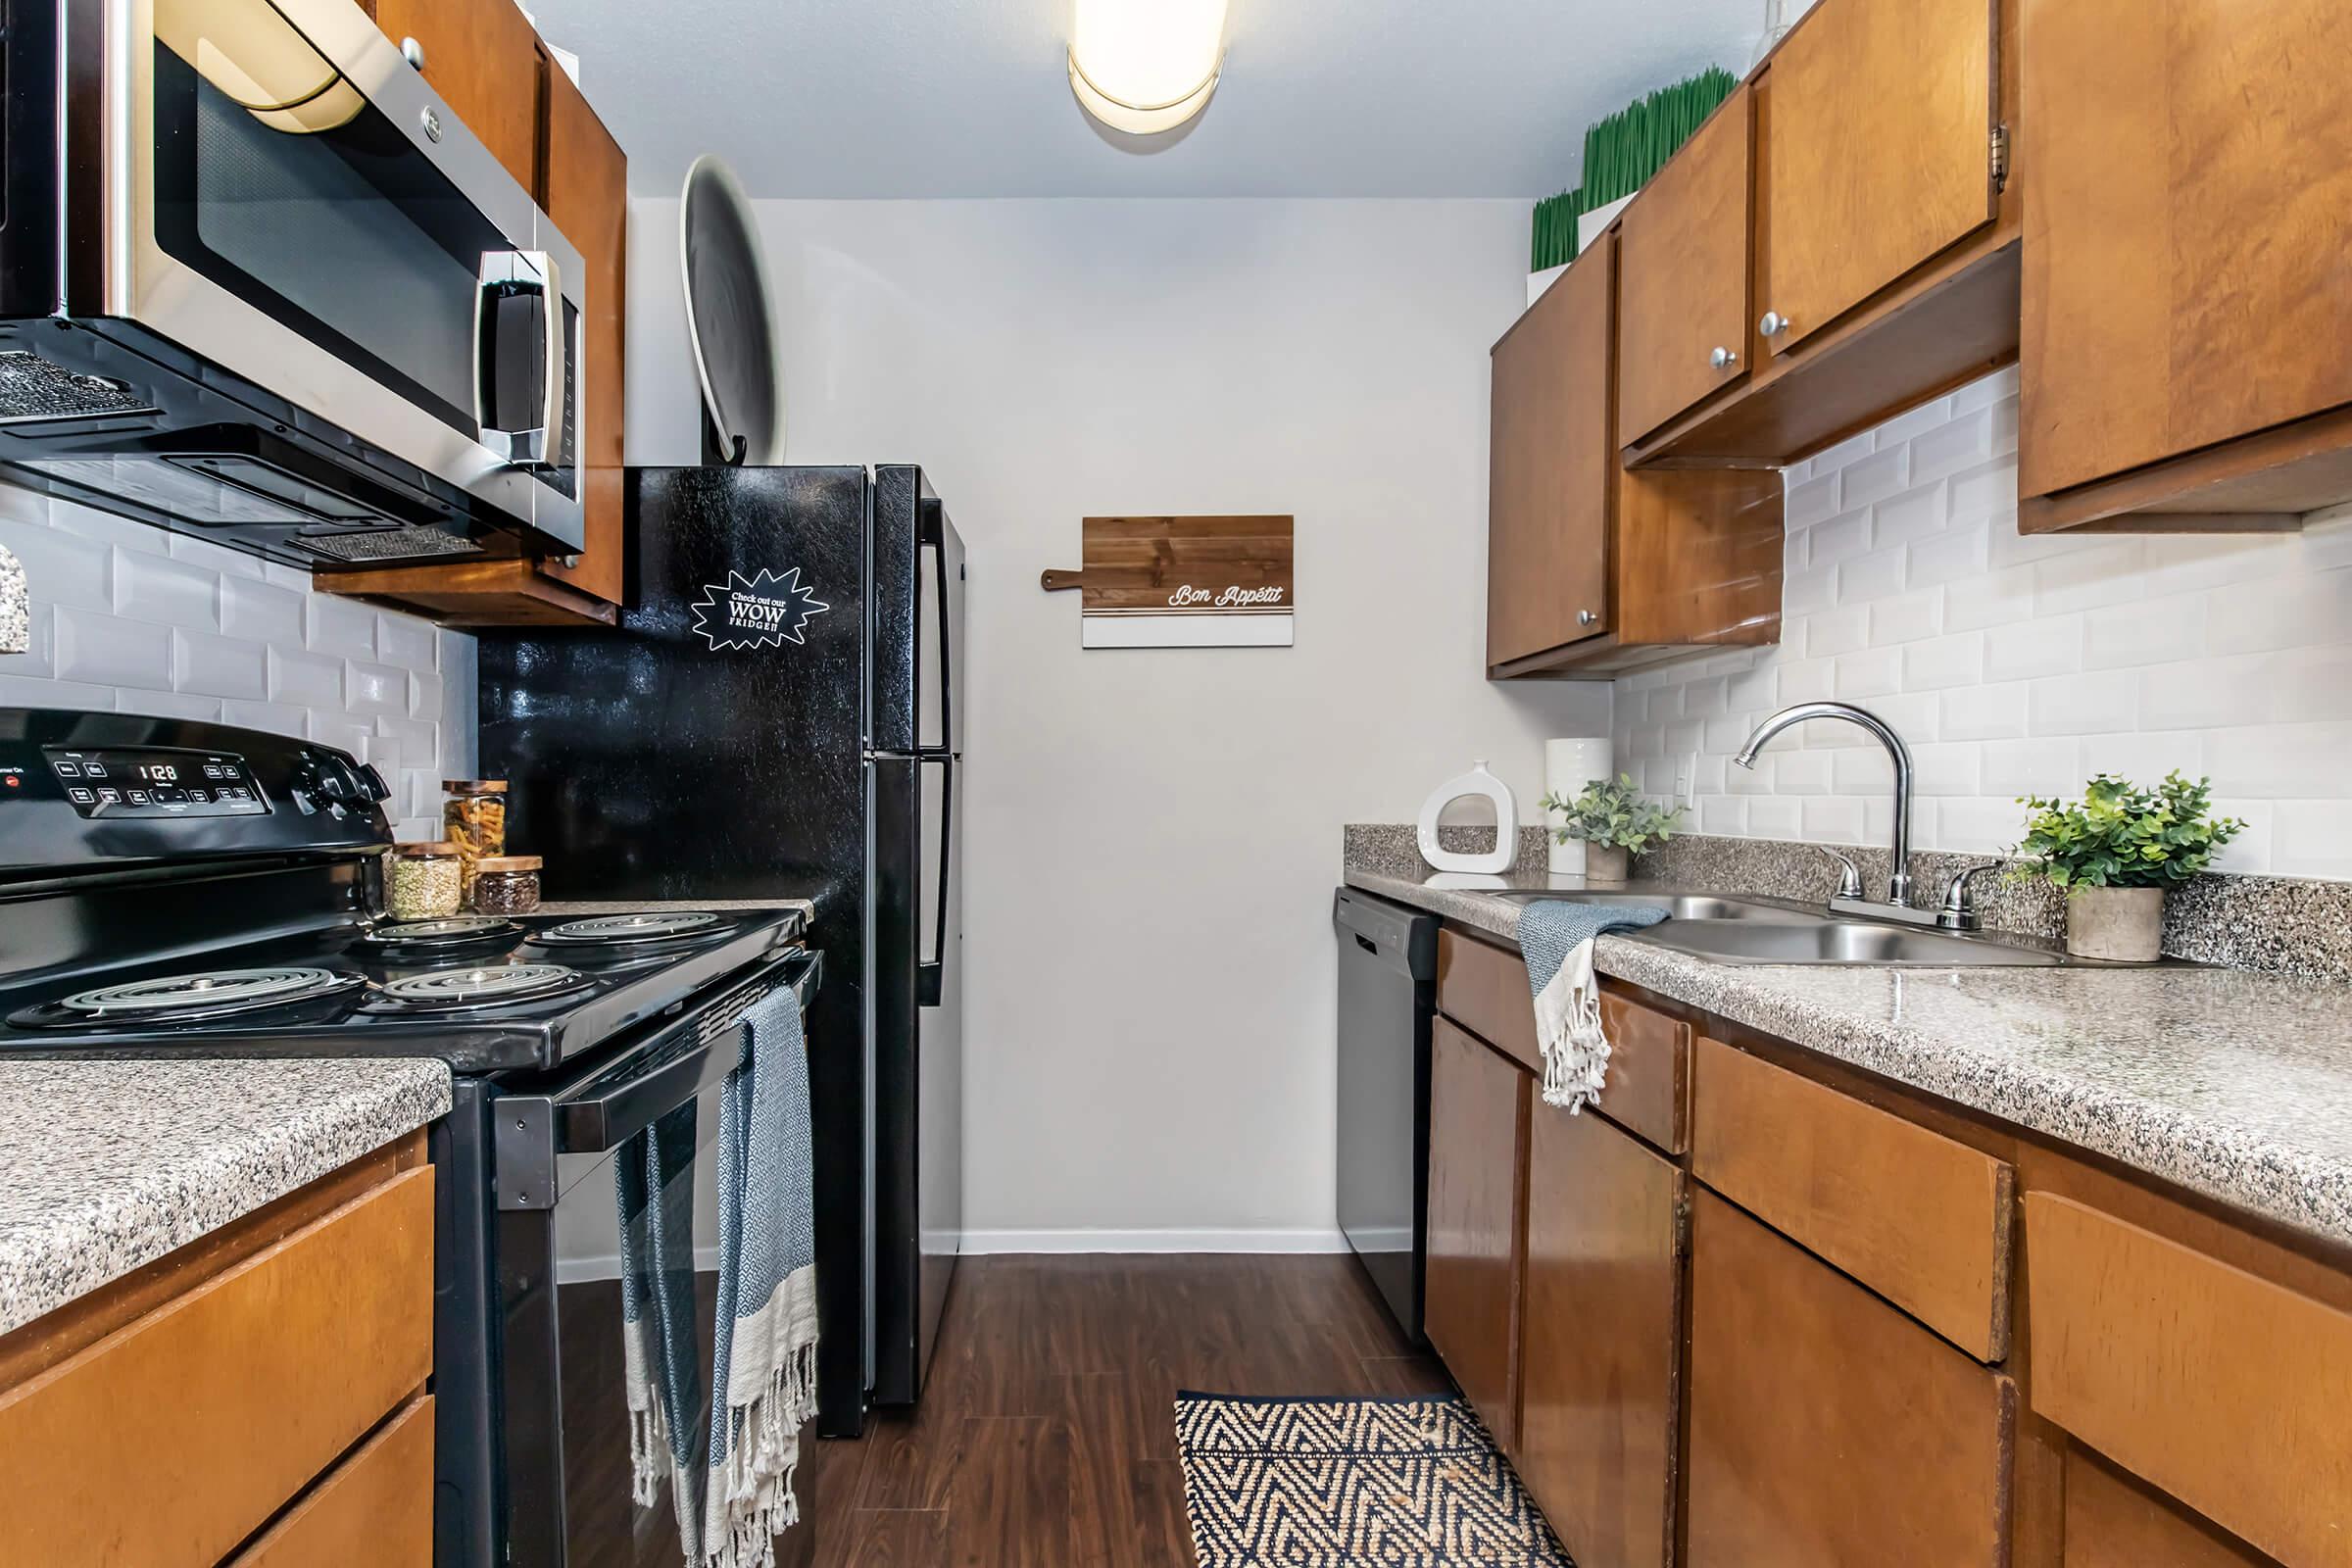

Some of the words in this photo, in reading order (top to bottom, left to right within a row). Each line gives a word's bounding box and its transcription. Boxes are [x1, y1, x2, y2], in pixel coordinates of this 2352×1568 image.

[731, 592, 757, 603] Check
[771, 599, 786, 608] our
[1168, 585, 1211, 606] Bon
[1215, 586, 1284, 606] Appétit
[729, 601, 787, 623] WOW
